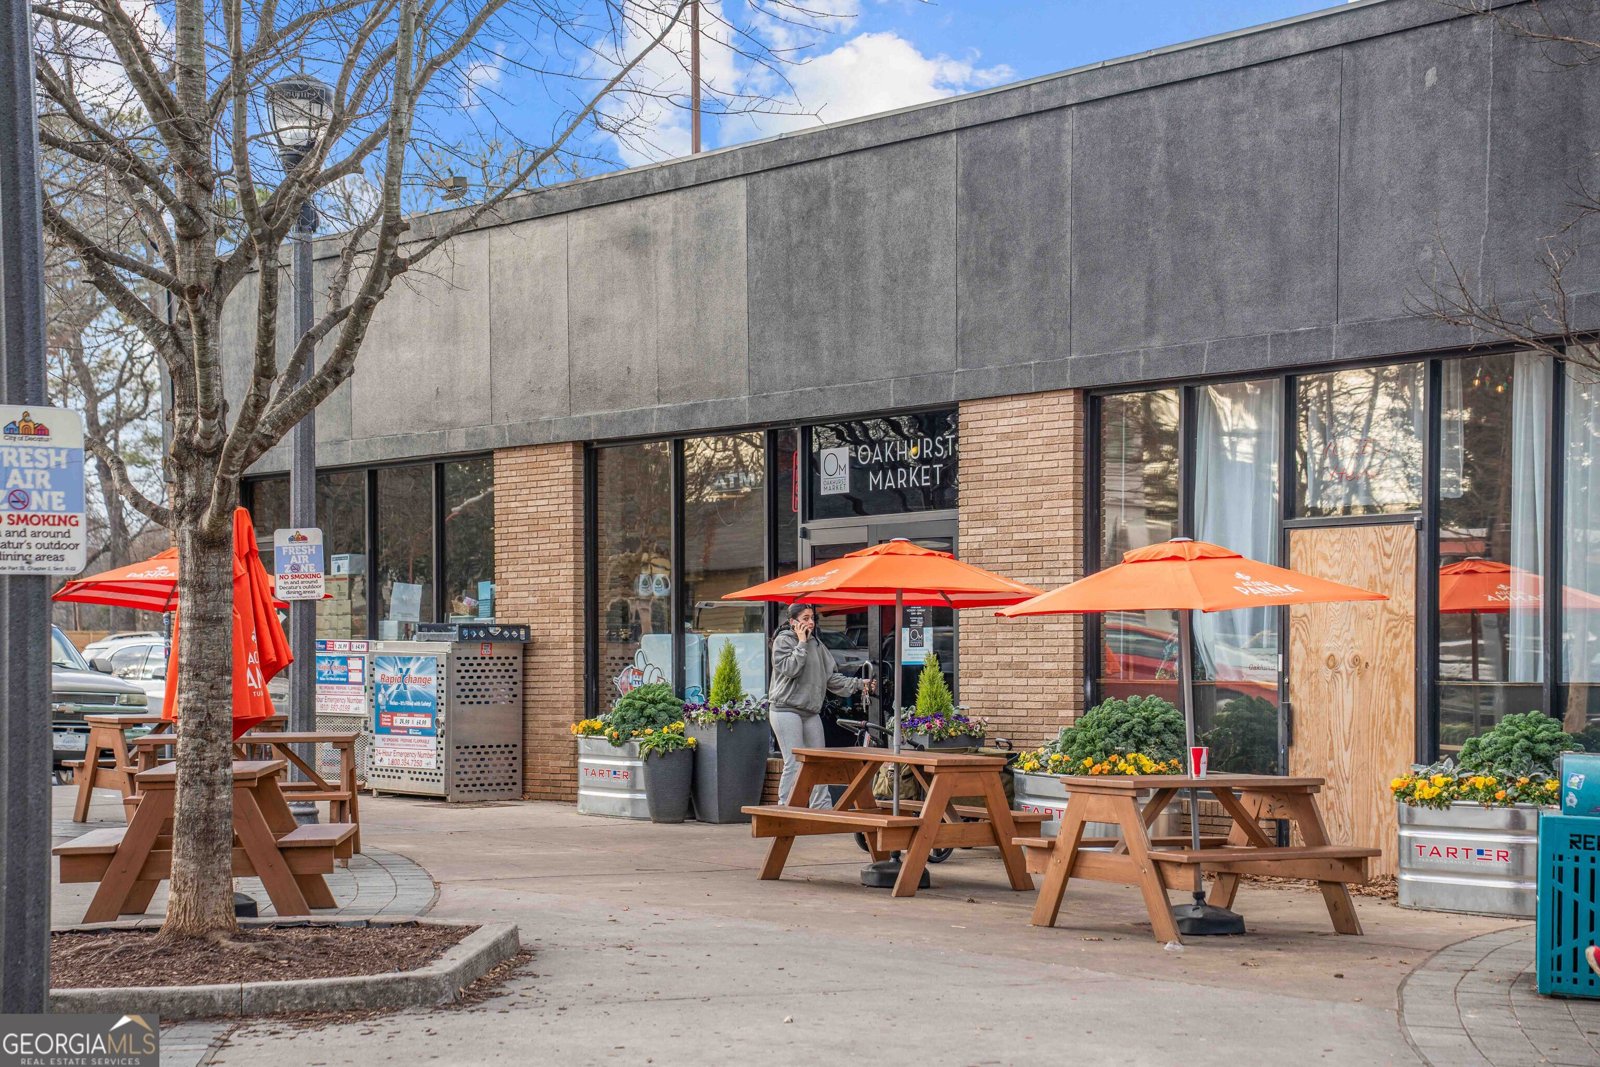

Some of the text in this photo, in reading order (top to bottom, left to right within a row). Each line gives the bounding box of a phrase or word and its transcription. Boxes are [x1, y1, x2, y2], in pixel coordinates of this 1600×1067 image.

[858, 435, 955, 465] OAKHURST
[0, 447, 68, 469] RESH
[6, 468, 52, 489] AIR
[869, 464, 943, 491] MARKET
[7, 514, 79, 527] SMOKING
[5, 528, 27, 538] and
[31, 529, 71, 539] around
[35, 541, 80, 550] outdoor
[282, 546, 316, 556] FRESH
[0, 551, 65, 563] ining areas
[290, 555, 310, 564] AIR
[584, 768, 629, 779] TARTER
[1415, 844, 1510, 862] TARTER
